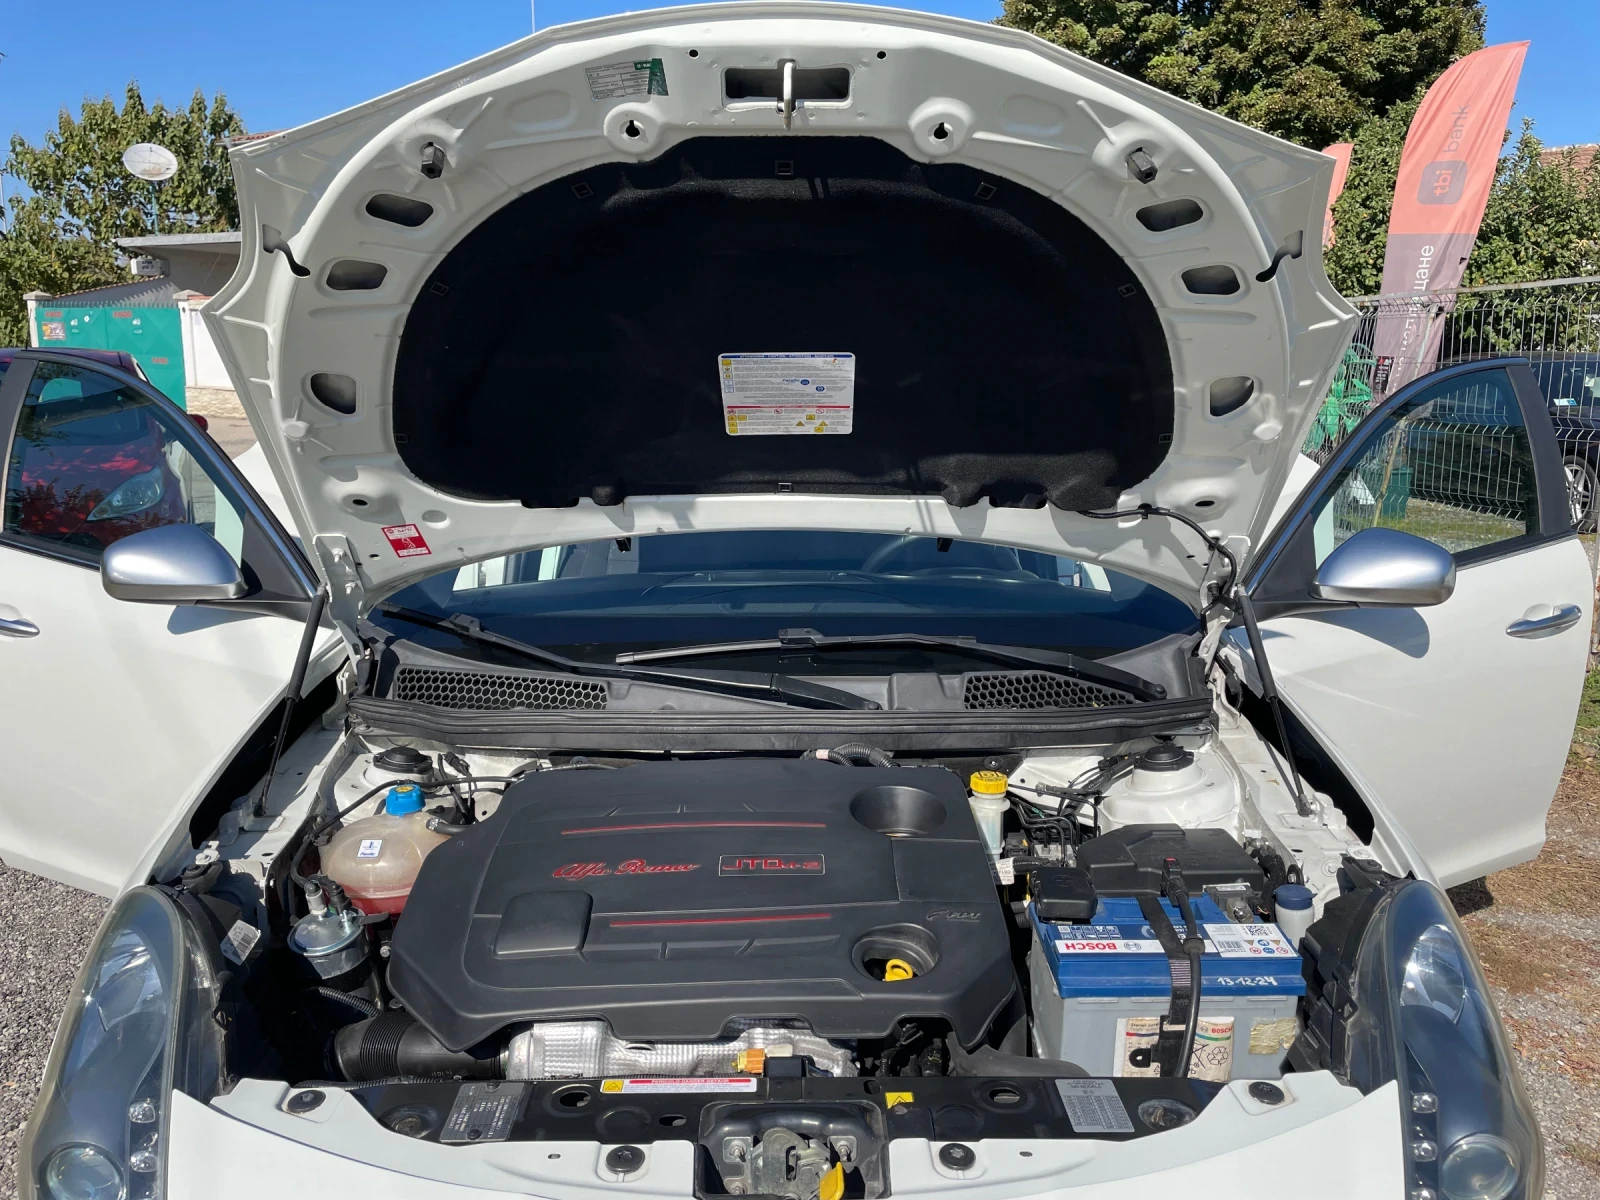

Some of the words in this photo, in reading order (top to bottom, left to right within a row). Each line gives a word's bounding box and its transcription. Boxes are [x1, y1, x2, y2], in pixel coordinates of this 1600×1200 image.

[1442, 104, 1470, 153] bank
[1433, 169, 1453, 197] tbi
[552, 862, 611, 881] Alfa
[614, 858, 700, 874] Romeo
[1064, 942, 1117, 951] BOSCH
